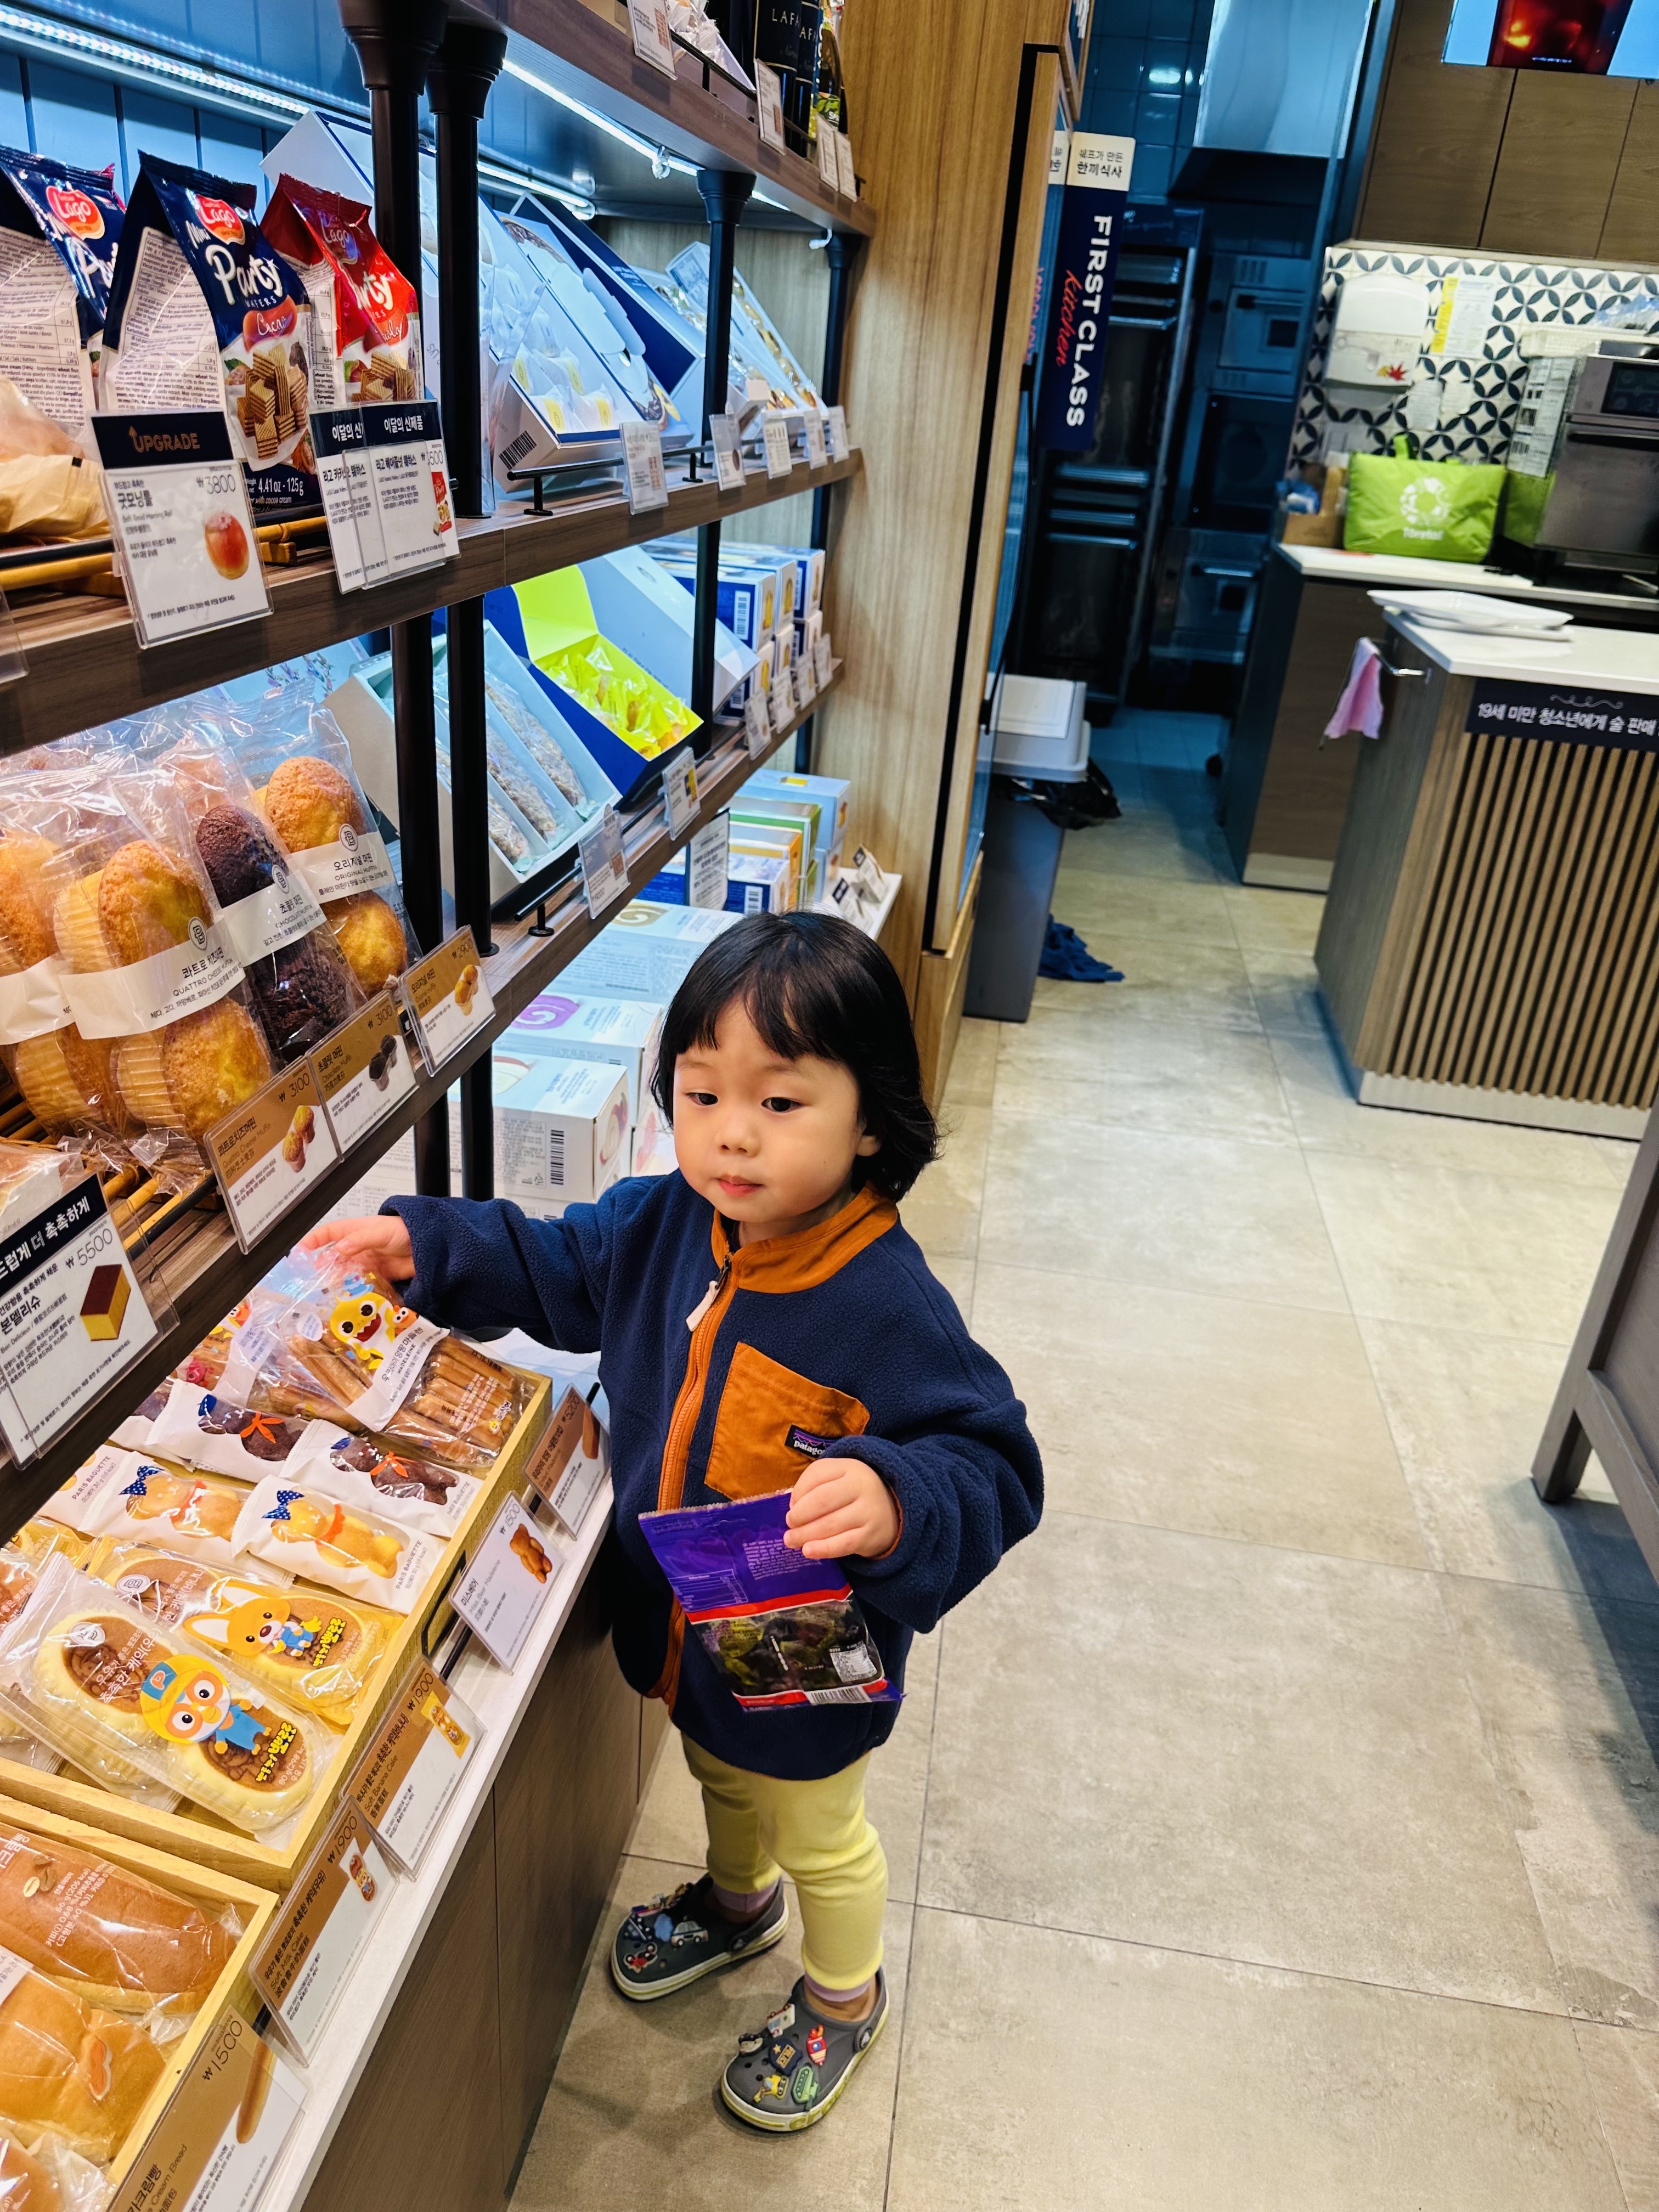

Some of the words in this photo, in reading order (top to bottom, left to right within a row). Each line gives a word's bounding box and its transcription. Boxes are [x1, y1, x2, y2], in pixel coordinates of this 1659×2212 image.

[1077, 161, 1123, 178] 한끼식사
[1107, 151, 1124, 163] 만든
[53, 192, 91, 223] Lago
[201, 207, 235, 228] Lago
[320, 214, 350, 247] Lago
[205, 244, 283, 305] Party
[1082, 216, 1112, 314] FIRST
[245, 295, 277, 308] WAFERS
[257, 312, 287, 336] Cacao
[1056, 269, 1083, 368] kitchen
[1066, 320, 1097, 427] CLASS
[332, 423, 354, 442] 이달의
[384, 417, 403, 433] 이달의
[405, 415, 424, 431] 신제품
[132, 432, 201, 453] UPGRADE
[323, 469, 334, 482] 라고
[376, 458, 386, 471] 라고
[117, 489, 154, 510] 굿모닝롤
[1478, 702, 1508, 720] 19세
[1507, 705, 1537, 724] 미만
[1538, 707, 1609, 731] 청소년에게
[1609, 715, 1626, 733] 술
[334, 855, 363, 871] 오리지널
[362, 853, 373, 862] 머핀
[335, 868, 364, 881] ORIGINAL
[319, 887, 334, 895] 플레인
[182, 960, 207, 978] 콰트로
[411, 975, 428, 994] 오리지널
[426, 968, 436, 980] 머핀
[173, 977, 206, 996] QUATTRO
[318, 1053, 332, 1073] 초콜릿
[332, 1045, 343, 1059] 머핀
[240, 1136, 257, 1153] Cheese
[31, 1231, 45, 1250] 더
[46, 1197, 89, 1238] 촉촉하게
[23, 1273, 46, 1295] 촉촉하게
[46, 1263, 58, 1276] 채운
[1, 1296, 40, 1335] 본델리슈
[381, 1356, 399, 1381] 우리아이
[394, 1344, 406, 1358] 앙팡
[403, 1327, 424, 1345] 마들렌
[398, 1344, 416, 1374] MADELEINE
[72, 1482, 88, 1499] PARIS
[86, 1456, 110, 1482] BAGUETTE
[453, 1481, 470, 1504] BAGUETTE
[396, 1572, 407, 1589] PARIS
[404, 1541, 422, 1571] BAGUETTE
[461, 1578, 478, 1605] 미스베어
[95, 1658, 120, 1686] 우유가
[116, 1645, 131, 1660] 좋은
[99, 1669, 129, 1705] 촉촉한
[126, 1627, 162, 1671] 케익(우유)
[377, 1742, 392, 1763] 촉촉한
[278, 1773, 288, 1786] 80
[290, 1768, 302, 1782] 우유
[364, 1796, 375, 1812] Soft
[372, 1772, 388, 1796] Banana
[386, 1755, 398, 1772] Cake
[370, 1788, 388, 1818] 香蕉蛋糕
[55, 1900, 66, 1914] 56
[59, 1905, 74, 1923] 0.68
[264, 1960, 276, 1979] 우유가
[274, 1948, 284, 1963] 좋은
[293, 1902, 308, 1927] 촉촉한
[306, 1870, 326, 1905] 케익(우유)
[270, 1971, 282, 1990] Soft
[281, 1953, 292, 1971] Milk
[291, 1932, 304, 1951] Cake
[202, 2021, 242, 2080] ₩1500
[151, 2174, 171, 2205] Cream
[169, 2144, 187, 2173] Bread
